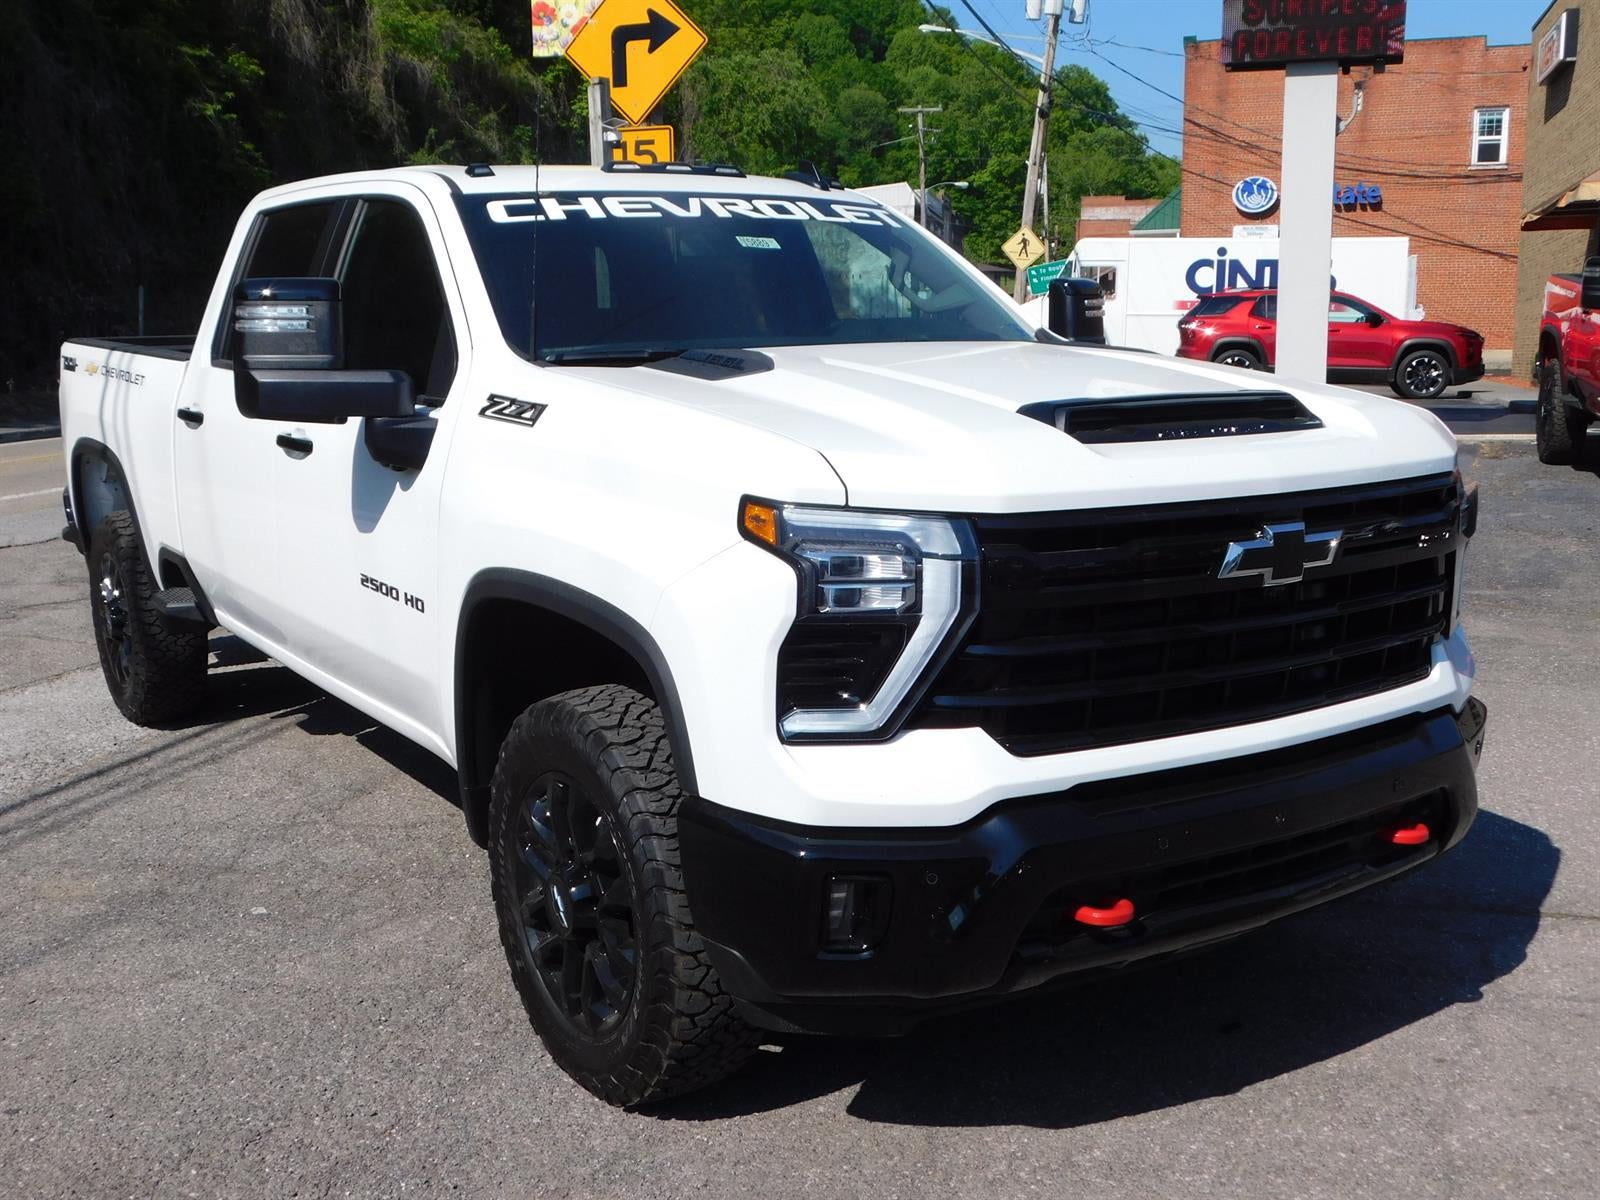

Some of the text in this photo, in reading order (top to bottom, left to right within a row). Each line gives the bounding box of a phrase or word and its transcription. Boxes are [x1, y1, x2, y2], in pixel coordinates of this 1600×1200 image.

[1236, 24, 1388, 58] FOREVER!
[620, 138, 658, 165] 15
[486, 196, 902, 229] CHEVROLET
[101, 365, 146, 387] CHEVROLET
[478, 393, 549, 428] Z71
[359, 572, 425, 614] 2500 HD
